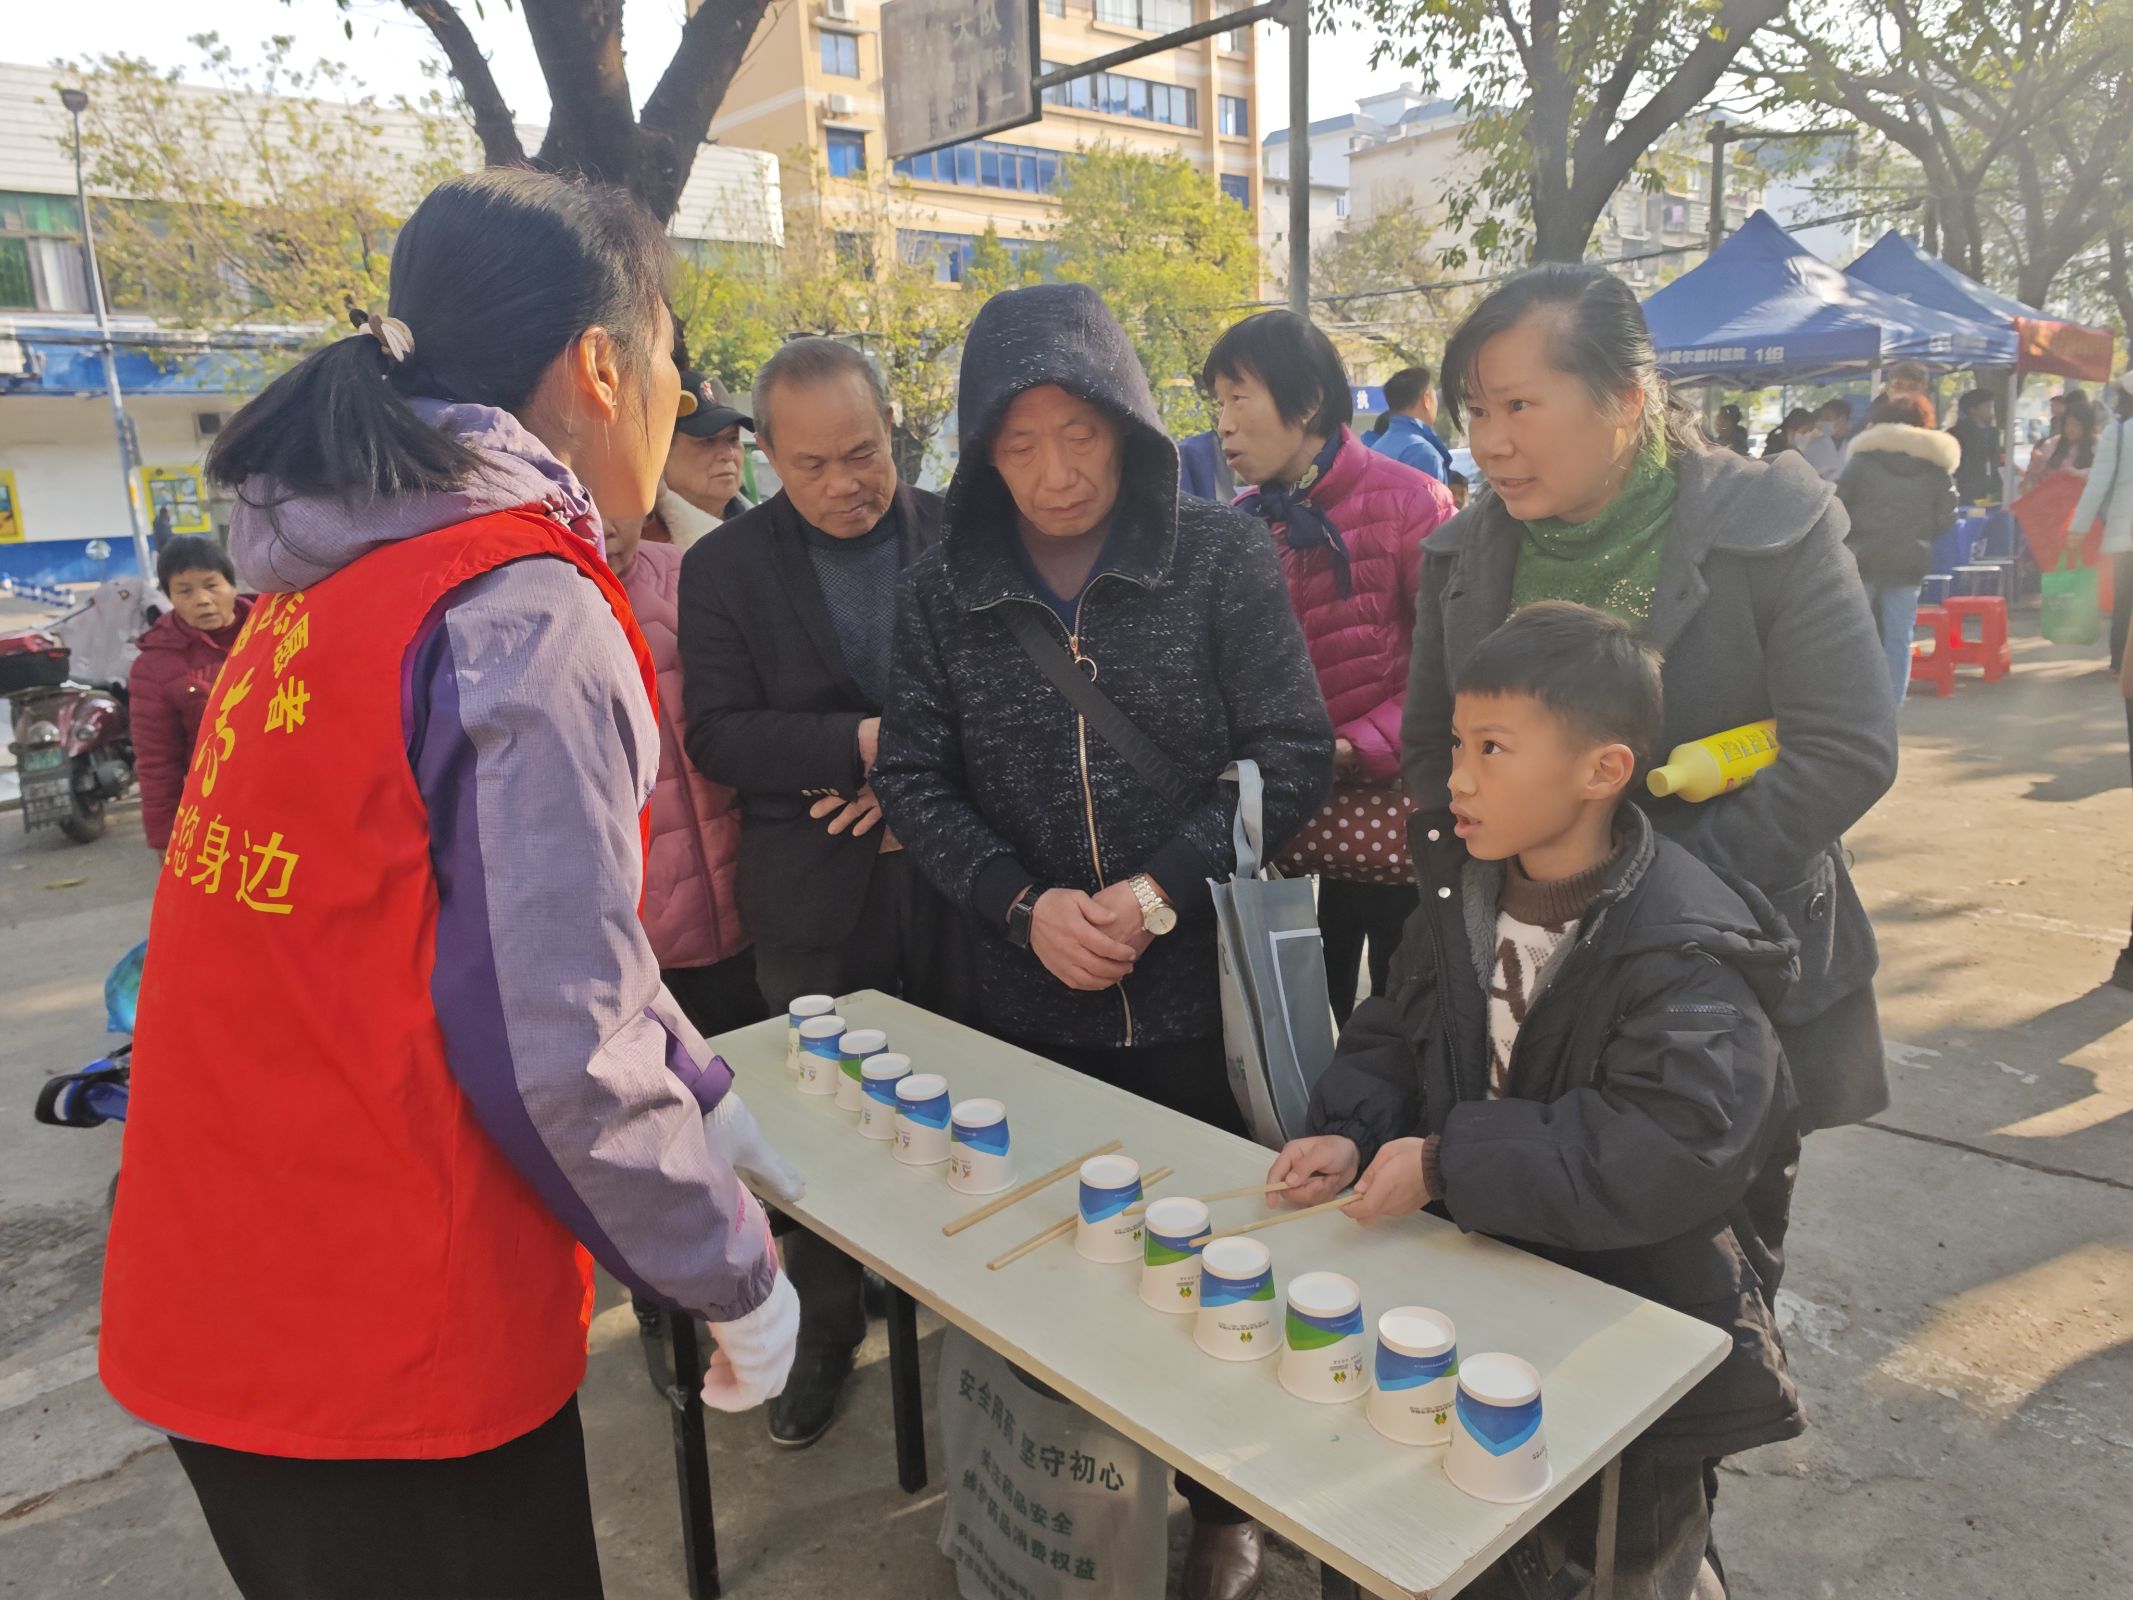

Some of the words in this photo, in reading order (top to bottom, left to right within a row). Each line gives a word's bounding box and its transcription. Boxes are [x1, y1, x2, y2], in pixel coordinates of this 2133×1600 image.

[165, 804, 300, 915] 您身边
[959, 1368, 1016, 1446] 安全用药
[1019, 1430, 1125, 1491] 坚守初心
[962, 1468, 1097, 1581] 维护药品消费权益
[980, 1446, 1074, 1537] 关注药品安全
